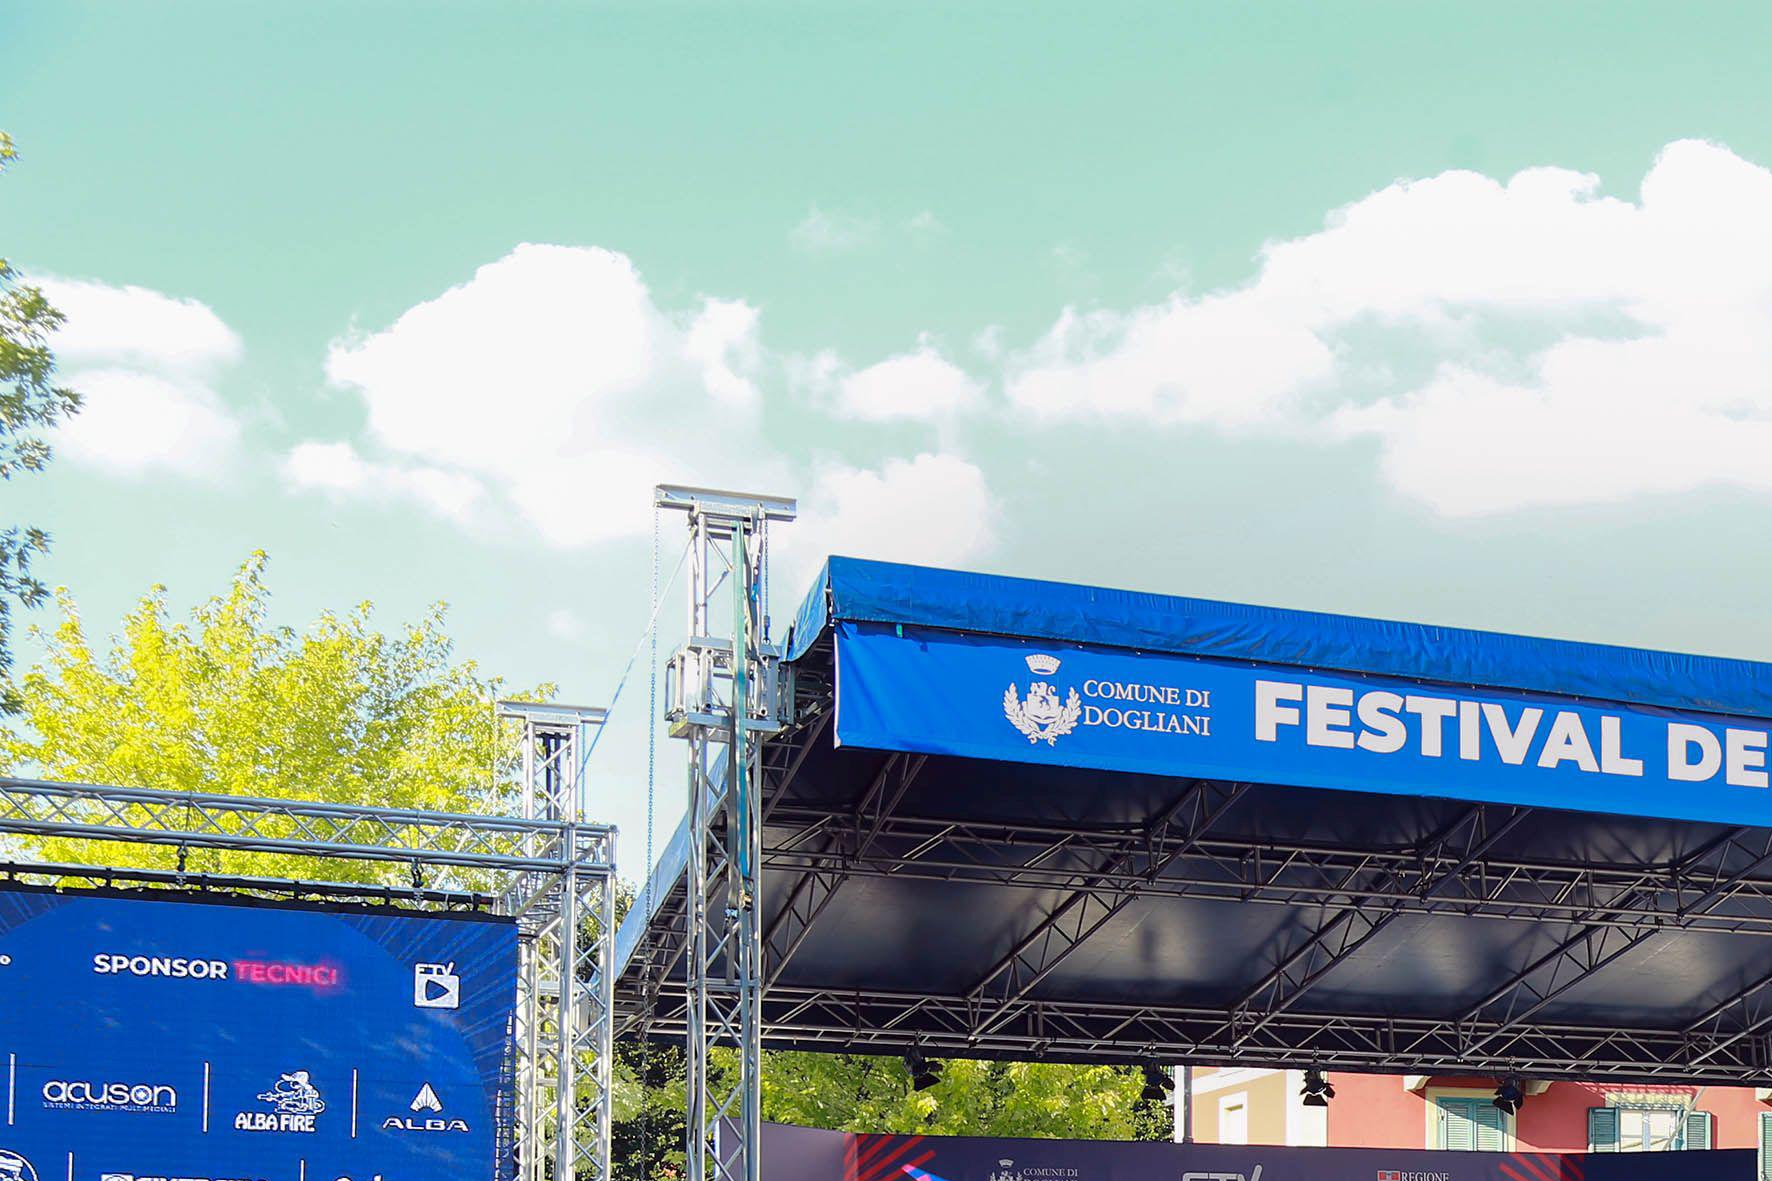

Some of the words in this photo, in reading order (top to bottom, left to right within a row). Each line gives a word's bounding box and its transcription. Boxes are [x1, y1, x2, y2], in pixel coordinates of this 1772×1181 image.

[1083, 679, 1180, 706] COMUNE
[1185, 686, 1210, 708] DI
[1083, 705, 1211, 737] DOGLIANI
[1254, 679, 1644, 777] FESTIVAL
[94, 953, 228, 979] SPONSOR
[233, 960, 337, 985] TECNICI
[43, 1081, 176, 1106] acuson
[235, 1112, 278, 1131] ALBA
[280, 1114, 316, 1132] FIRE
[382, 1117, 470, 1132] ALBA
[1023, 1168, 1065, 1178] COMUNE
[1067, 1168, 1078, 1177] DI
